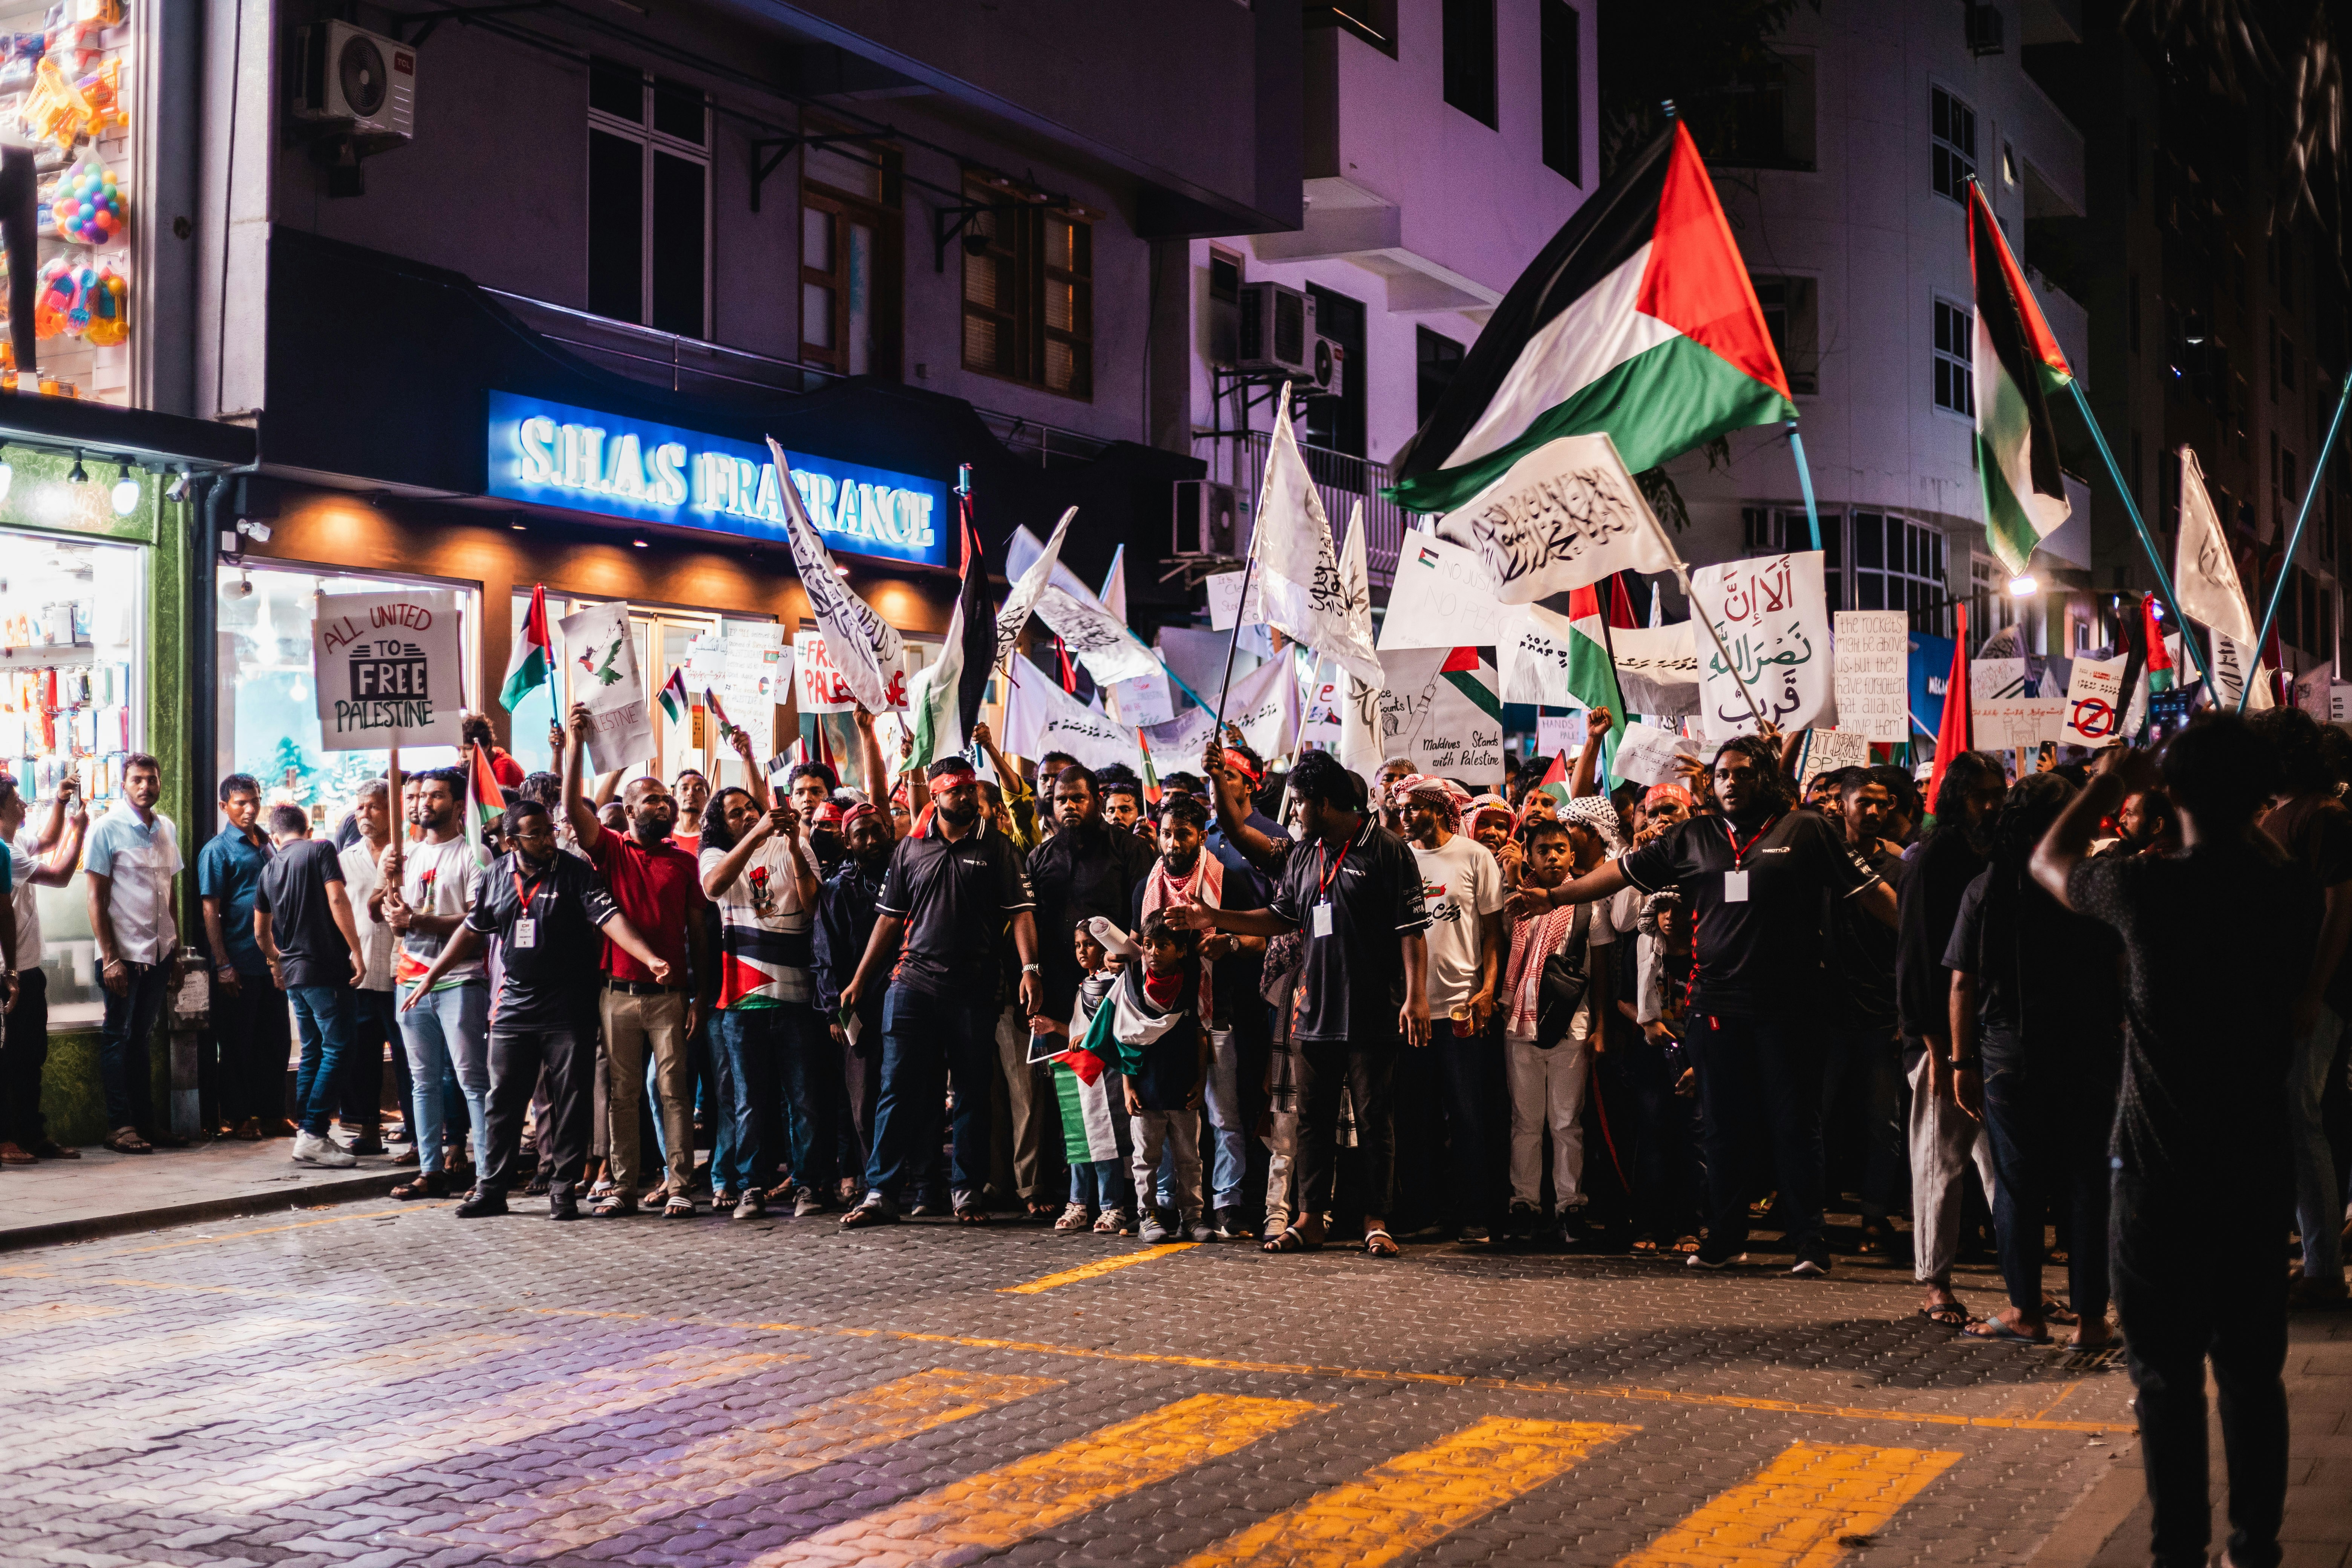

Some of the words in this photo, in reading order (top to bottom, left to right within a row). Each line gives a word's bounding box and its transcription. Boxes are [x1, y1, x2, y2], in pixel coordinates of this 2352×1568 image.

[397, 57, 410, 69] TCL
[703, 452, 935, 547] FRAGRANCE
[1442, 560, 1462, 580] NO
[1424, 585, 1456, 616] NO
[1461, 600, 1524, 645] PEACE
[324, 616, 364, 655] ALL
[370, 603, 432, 631] UNITED
[1862, 616, 1903, 634] rockets
[374, 639, 401, 657] TO
[1836, 637, 1861, 653] might
[1864, 636, 1875, 652] be
[1876, 636, 1906, 653] above
[1854, 657, 1871, 673] but
[1876, 657, 1898, 674] they
[358, 662, 425, 695] FREE
[1837, 677, 1862, 695] have
[1864, 677, 1905, 695] forgotten
[805, 669, 908, 707] PALENE
[586, 697, 605, 715] REE
[1835, 697, 1856, 714] that
[1862, 697, 1889, 714] allah
[334, 700, 435, 733] PALESTINE
[1542, 719, 1574, 729] HANDS
[1472, 730, 1499, 748] Stands
[1830, 733, 1865, 760] ISRAEL
[1432, 752, 1454, 767] with
[1460, 750, 1499, 766] Palestine
